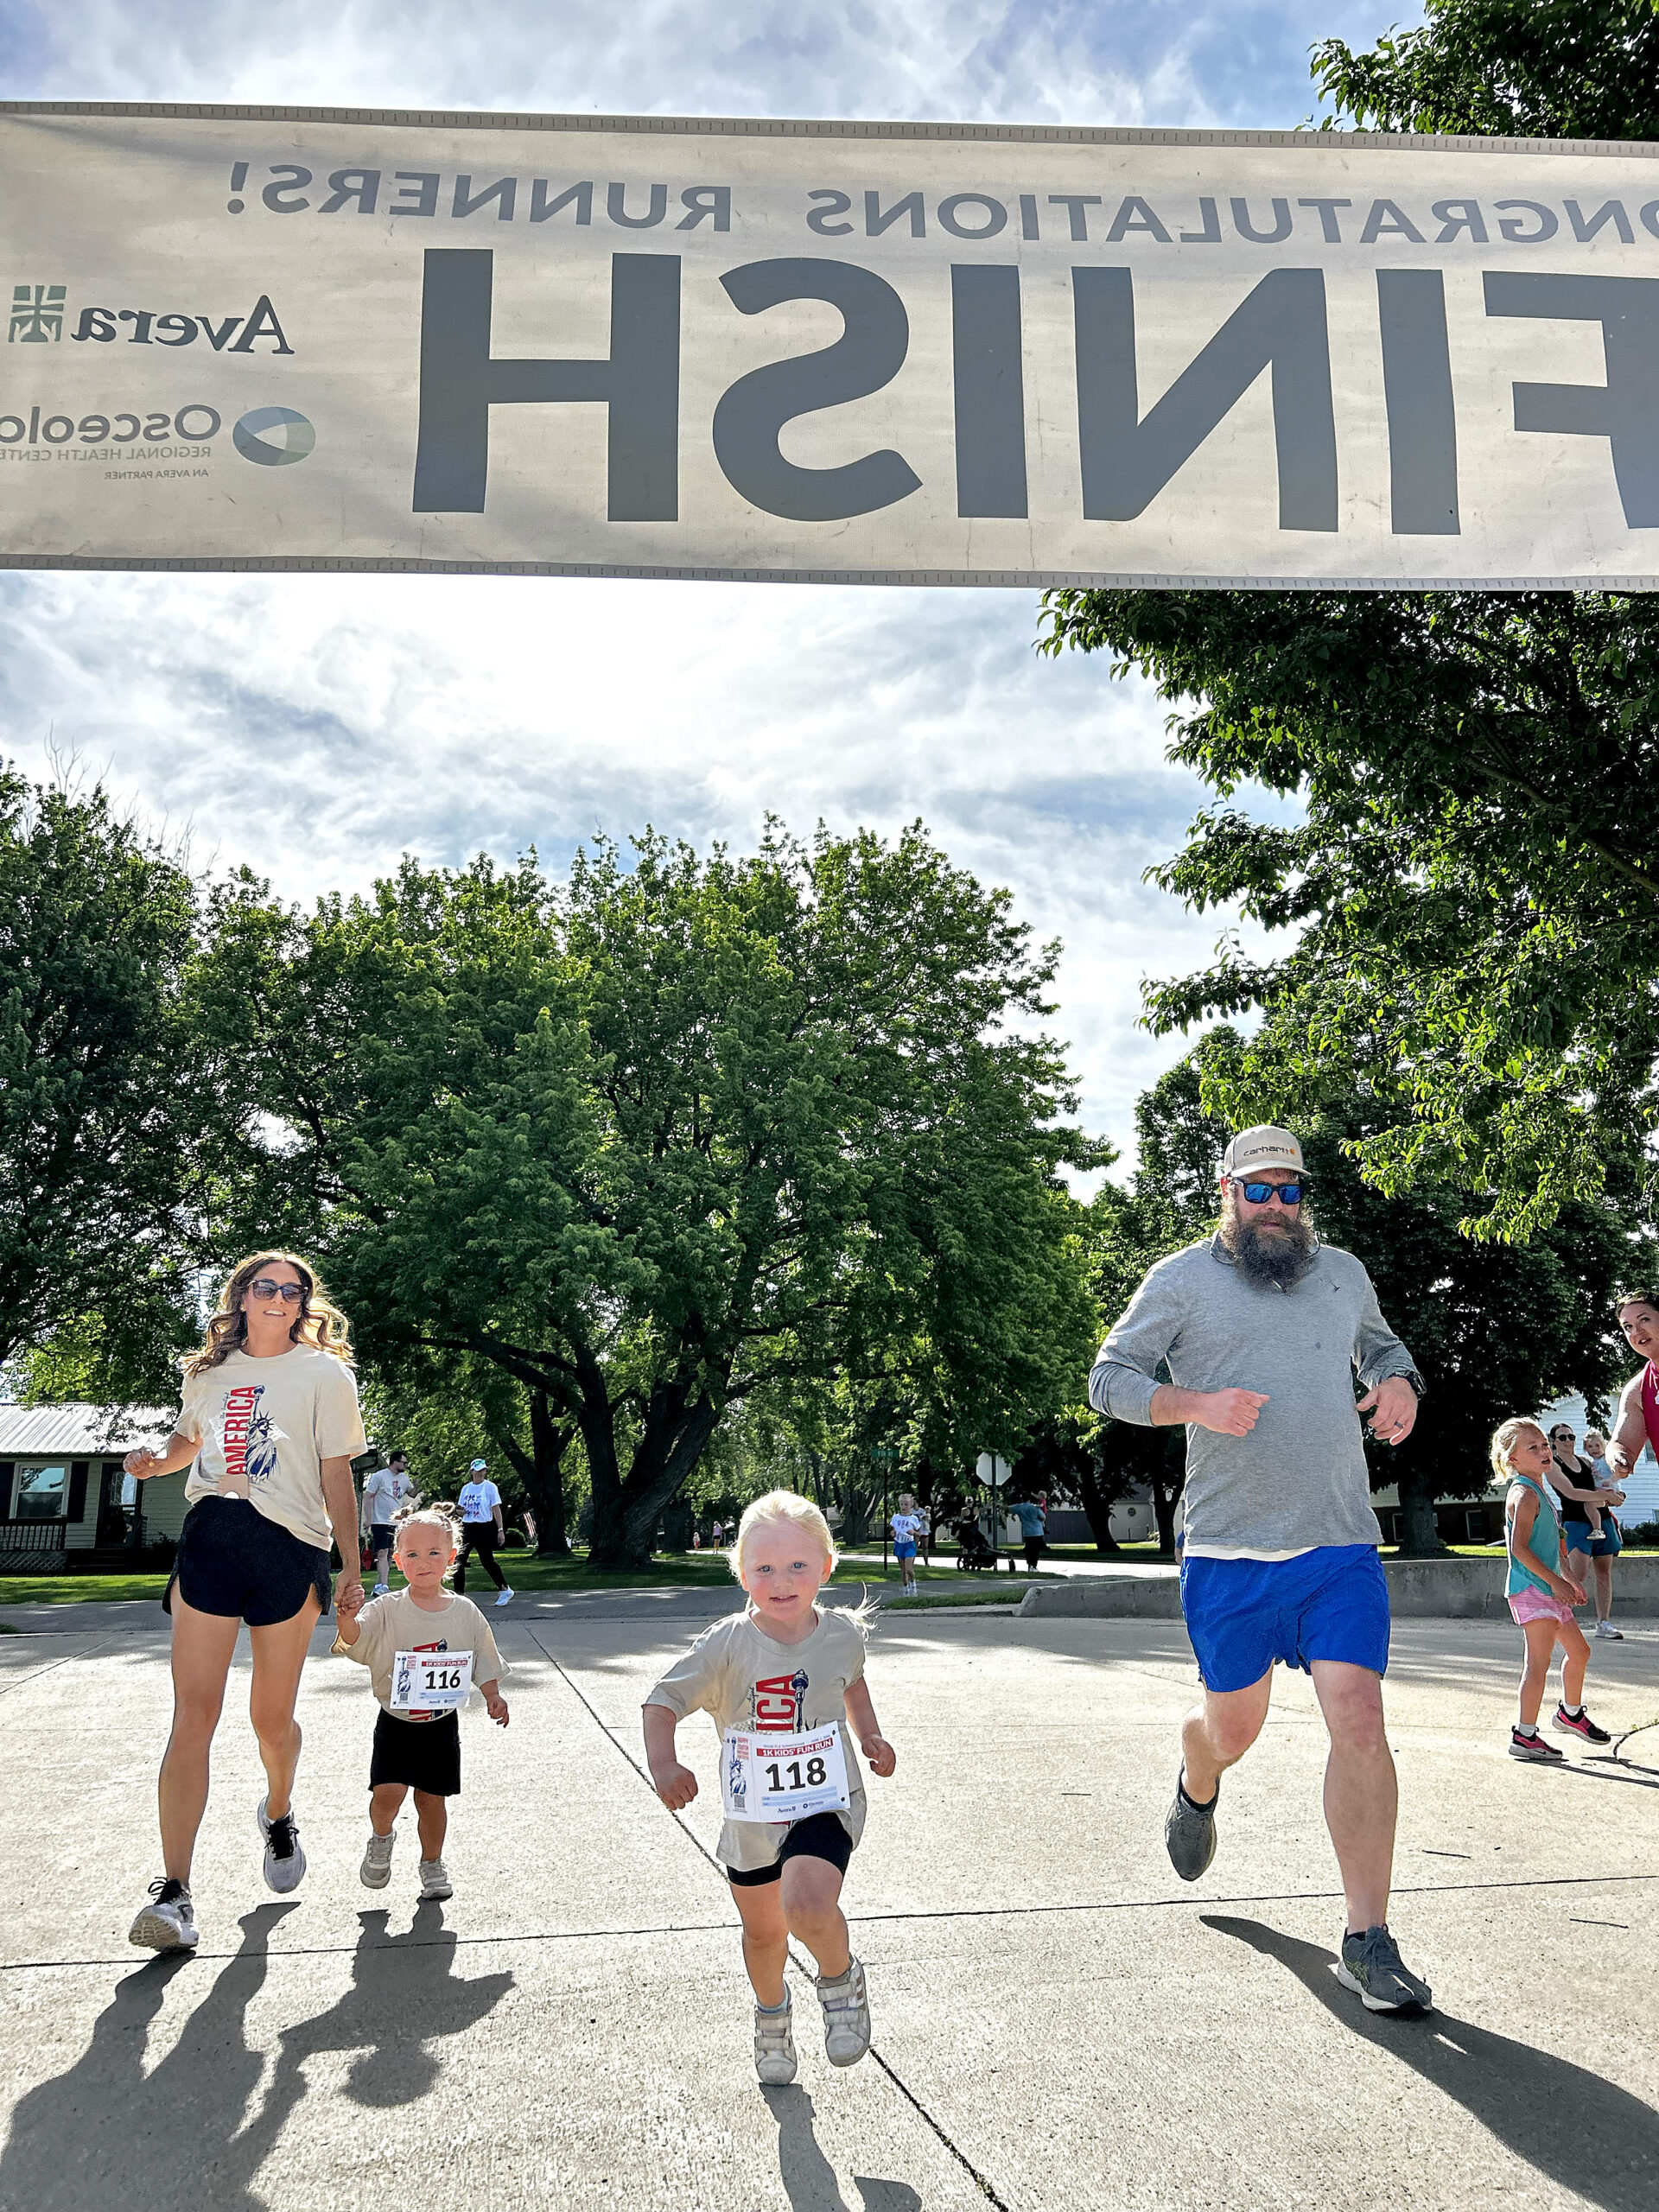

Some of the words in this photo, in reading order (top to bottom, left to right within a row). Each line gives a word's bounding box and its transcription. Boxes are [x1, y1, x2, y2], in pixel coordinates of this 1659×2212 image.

[224, 1386, 256, 1475] AMERICA
[425, 1669, 461, 1689] 116
[774, 1747, 796, 1757] KIDS'
[797, 1745, 814, 1755] FUN
[815, 1738, 832, 1750] RUN
[765, 1757, 827, 1792] 118
